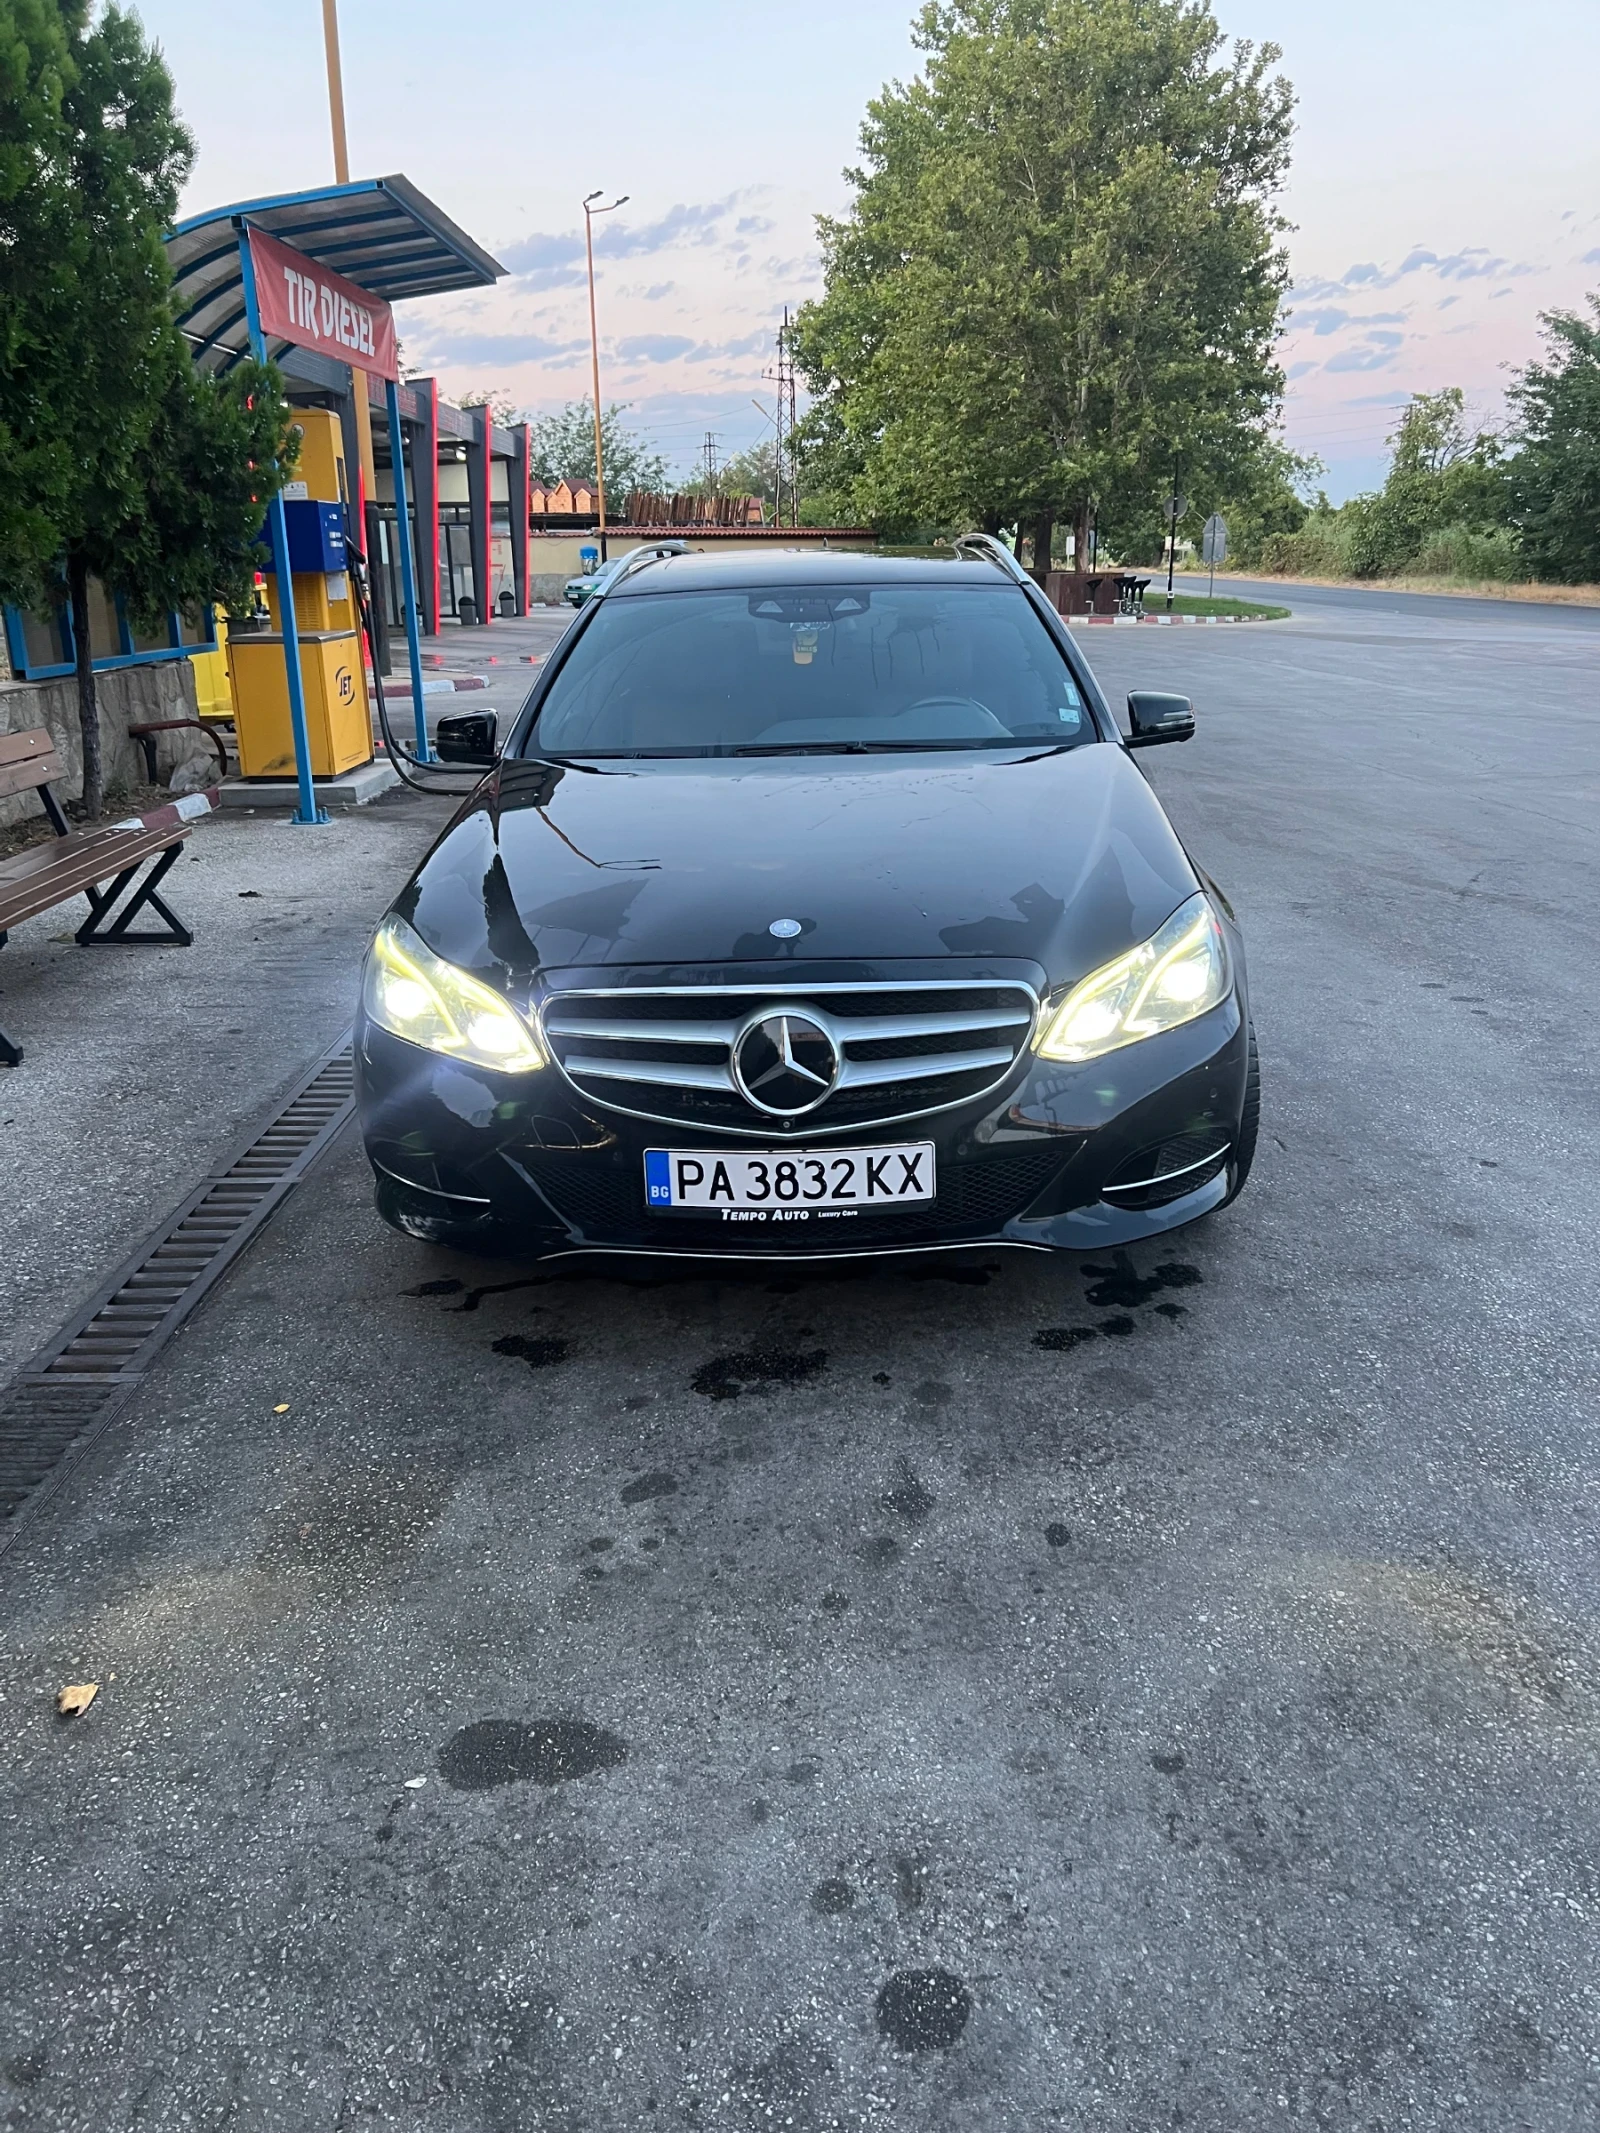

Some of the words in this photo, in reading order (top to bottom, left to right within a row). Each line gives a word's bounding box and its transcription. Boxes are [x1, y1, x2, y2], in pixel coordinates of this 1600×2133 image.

[284, 266, 319, 340] TIR
[320, 285, 376, 357] DIESEL
[339, 675, 352, 697] JET
[677, 1159, 735, 1201] PA
[746, 1158, 857, 1201] 3832
[866, 1152, 924, 1197] KX
[651, 1186, 669, 1199] BG
[772, 1209, 810, 1221] AUTO
[818, 1211, 842, 1219] Luxury
